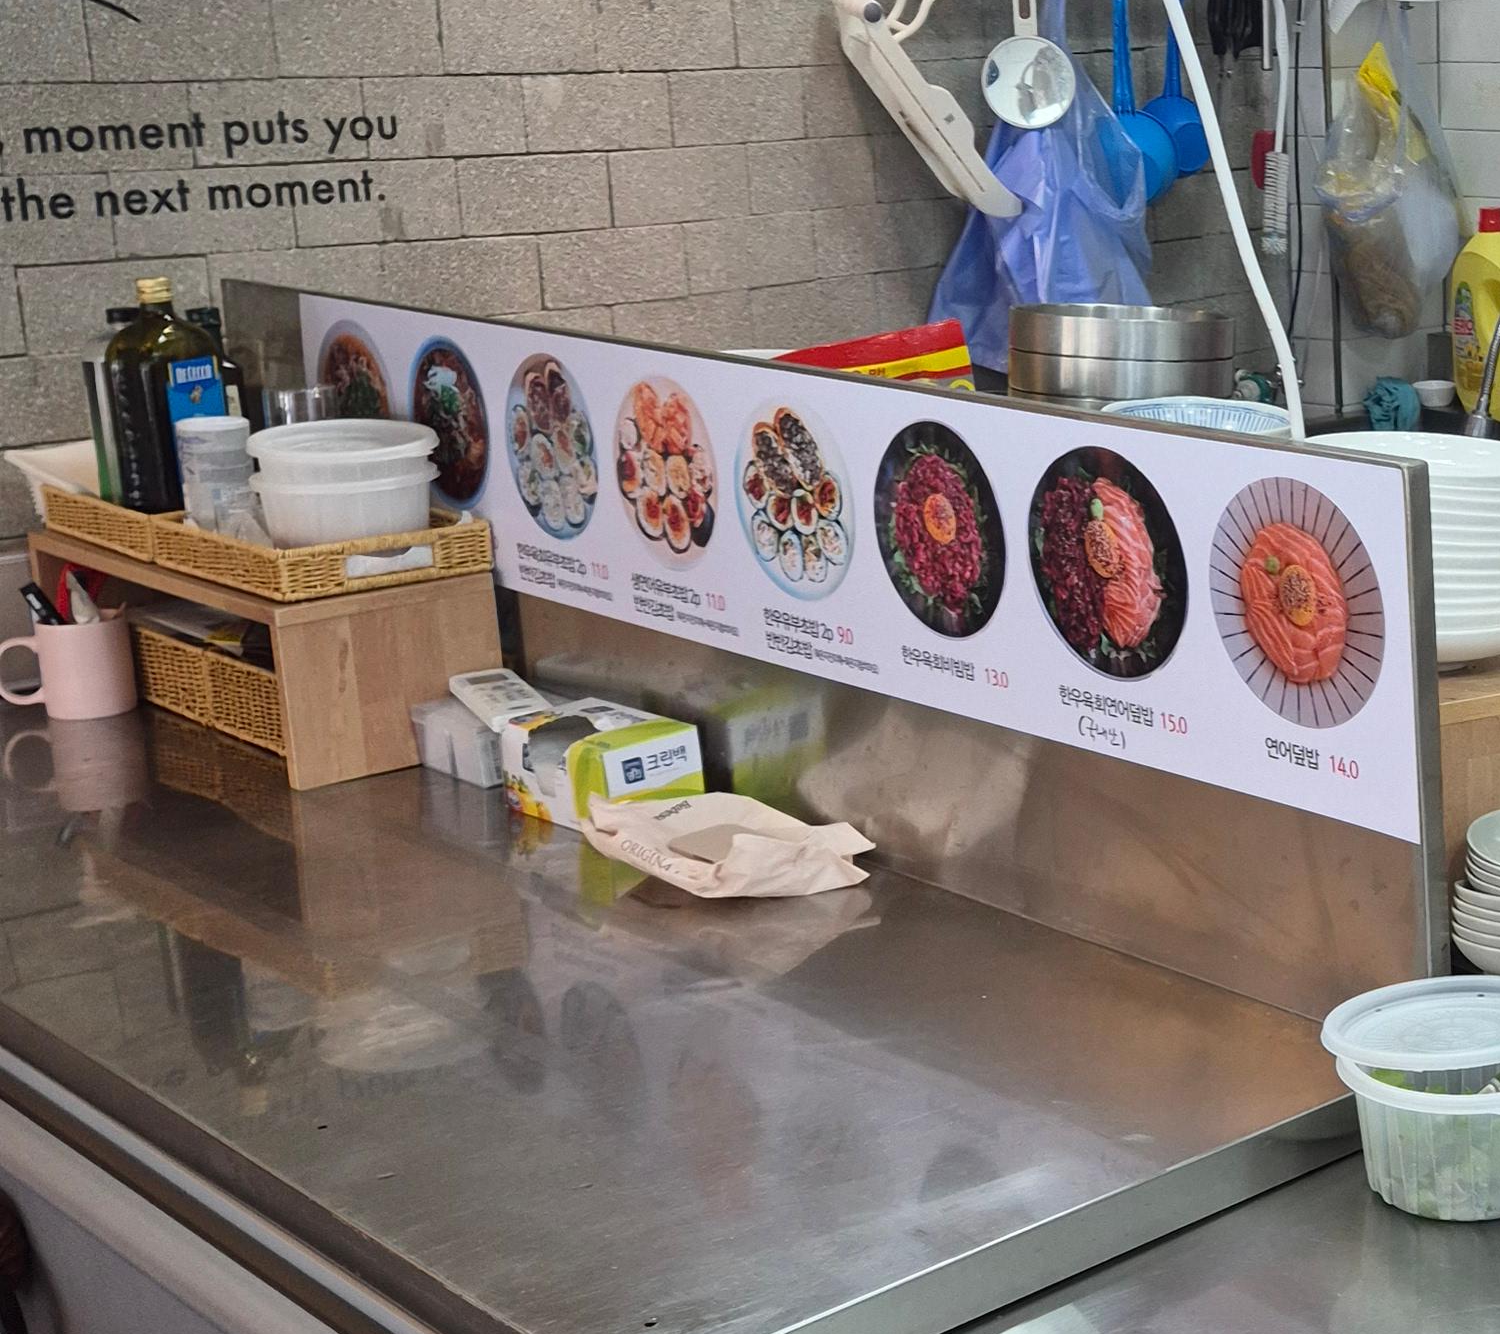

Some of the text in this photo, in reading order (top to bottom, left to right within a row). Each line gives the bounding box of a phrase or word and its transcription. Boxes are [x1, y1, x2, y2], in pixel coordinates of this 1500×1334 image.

[22, 110, 398, 159] moment puts you
[0, 170, 386, 223] the next moment.
[901, 645, 976, 682] 한우육회비빔밥
[1059, 684, 1188, 735] 한우육회연어덮밥 15.0
[645, 745, 688, 772] 크린백
[1265, 737, 1359, 780] 연어덮밥 14.0
